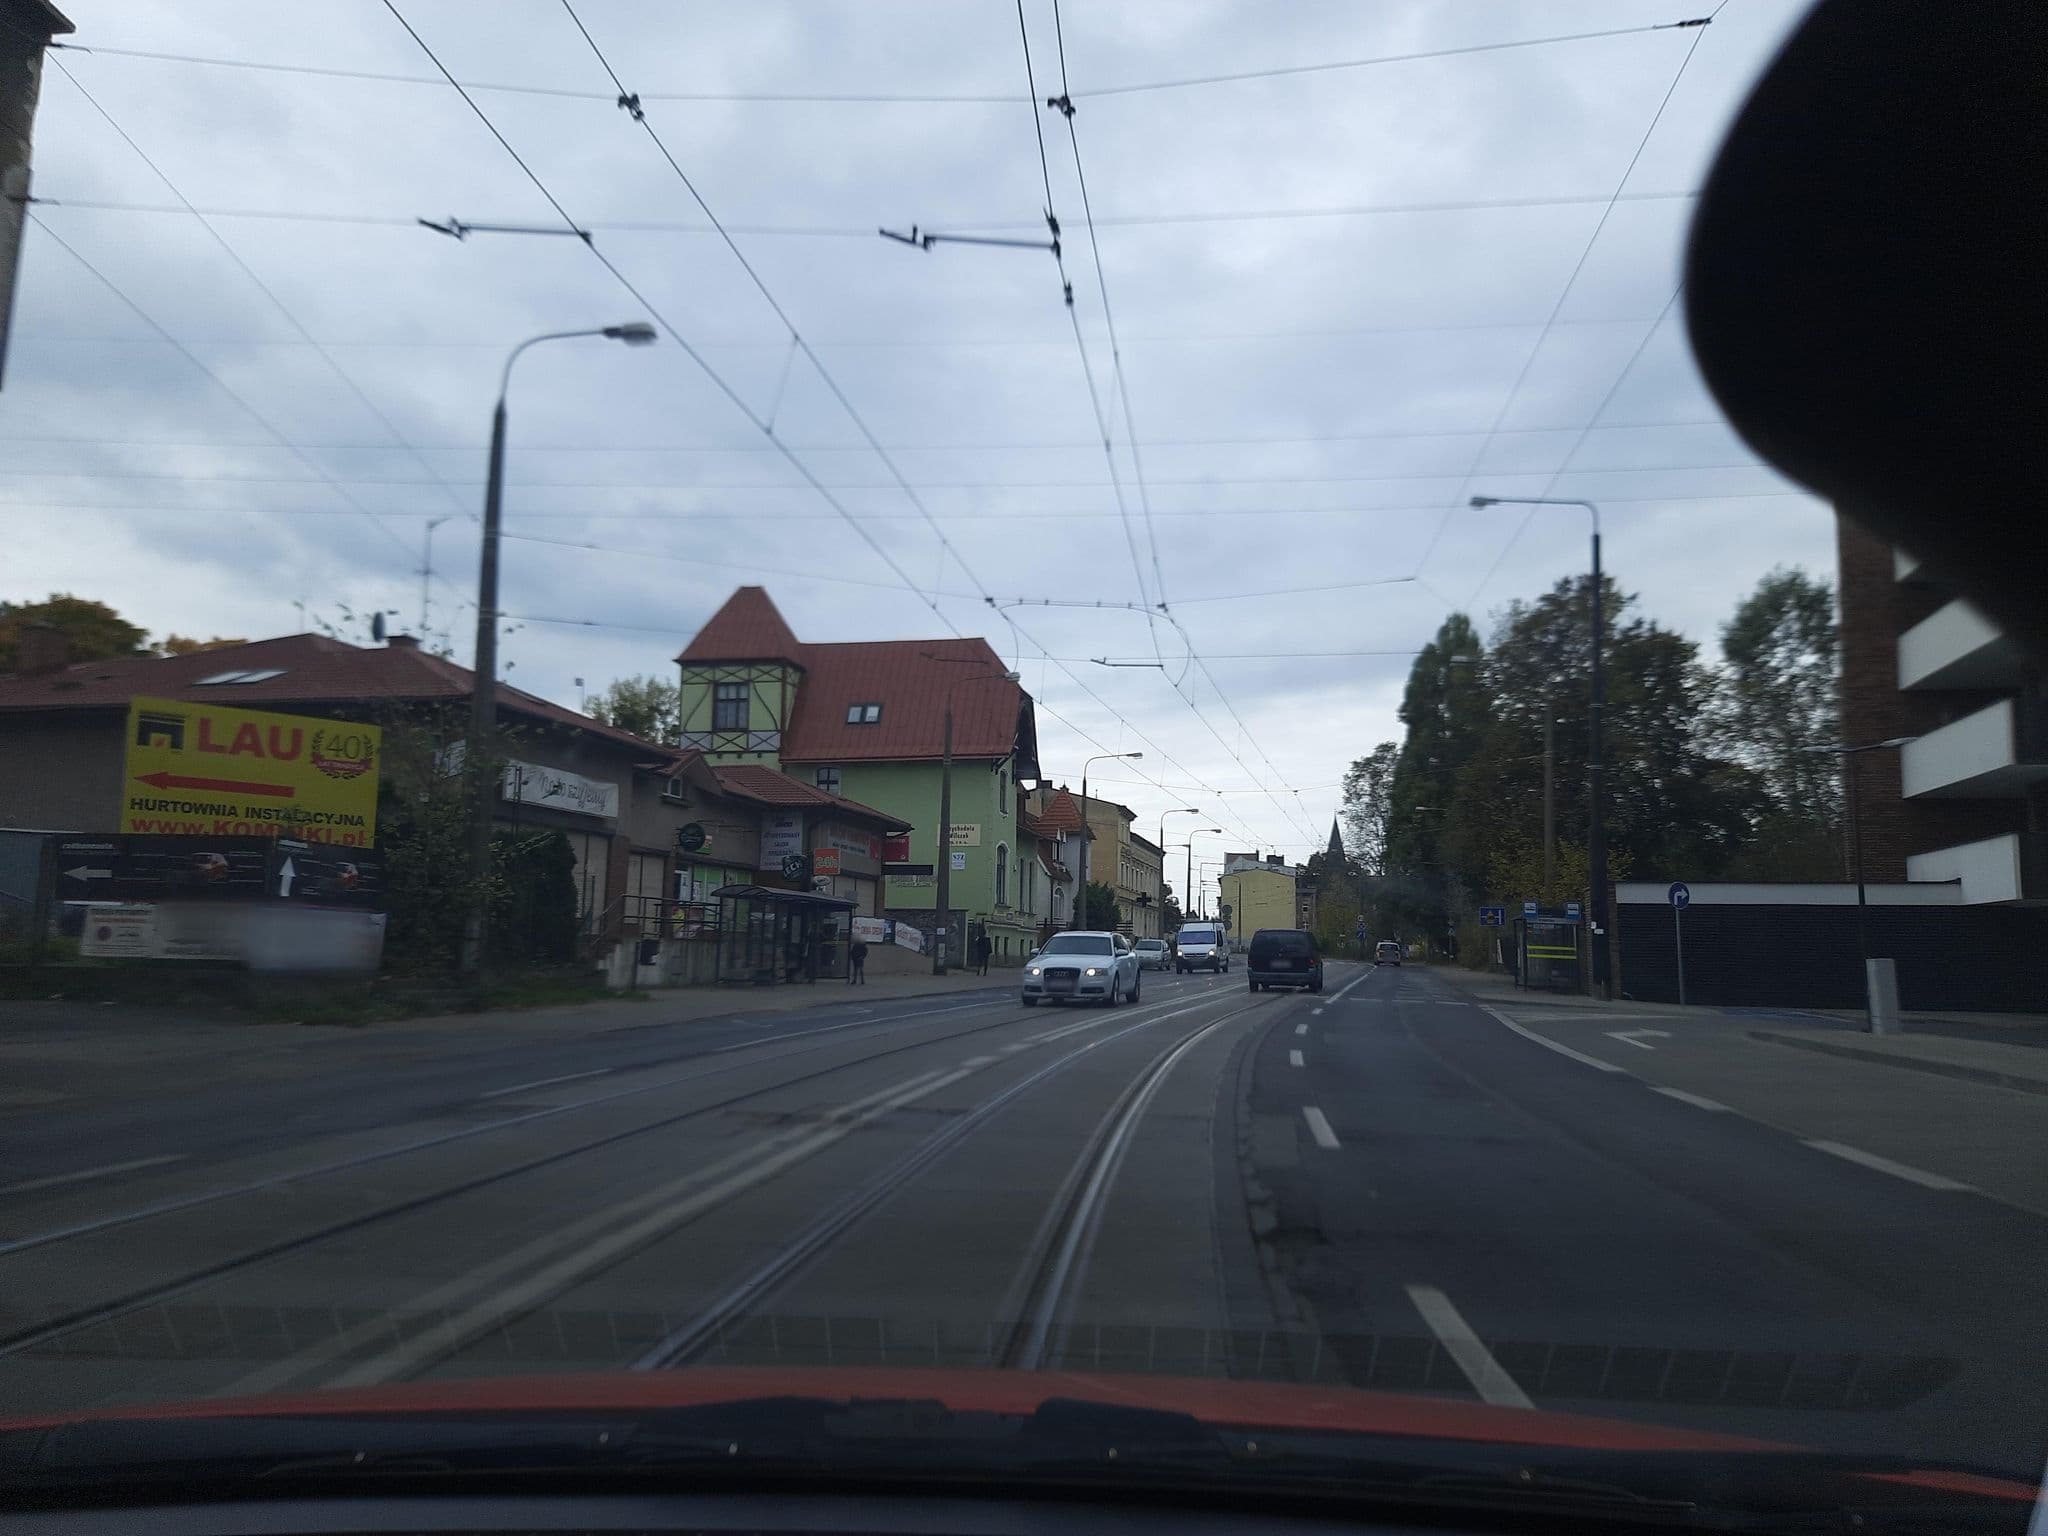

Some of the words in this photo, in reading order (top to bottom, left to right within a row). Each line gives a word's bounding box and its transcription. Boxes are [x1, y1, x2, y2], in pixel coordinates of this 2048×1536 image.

[197, 716, 304, 762] LAU
[326, 734, 361, 759] 40
[130, 798, 239, 818] HURTOWNIA
[244, 806, 366, 826] INSTALACYJNA
[129, 818, 368, 847] www.KOMKI.pl
[949, 825, 975, 833] rychodnia
